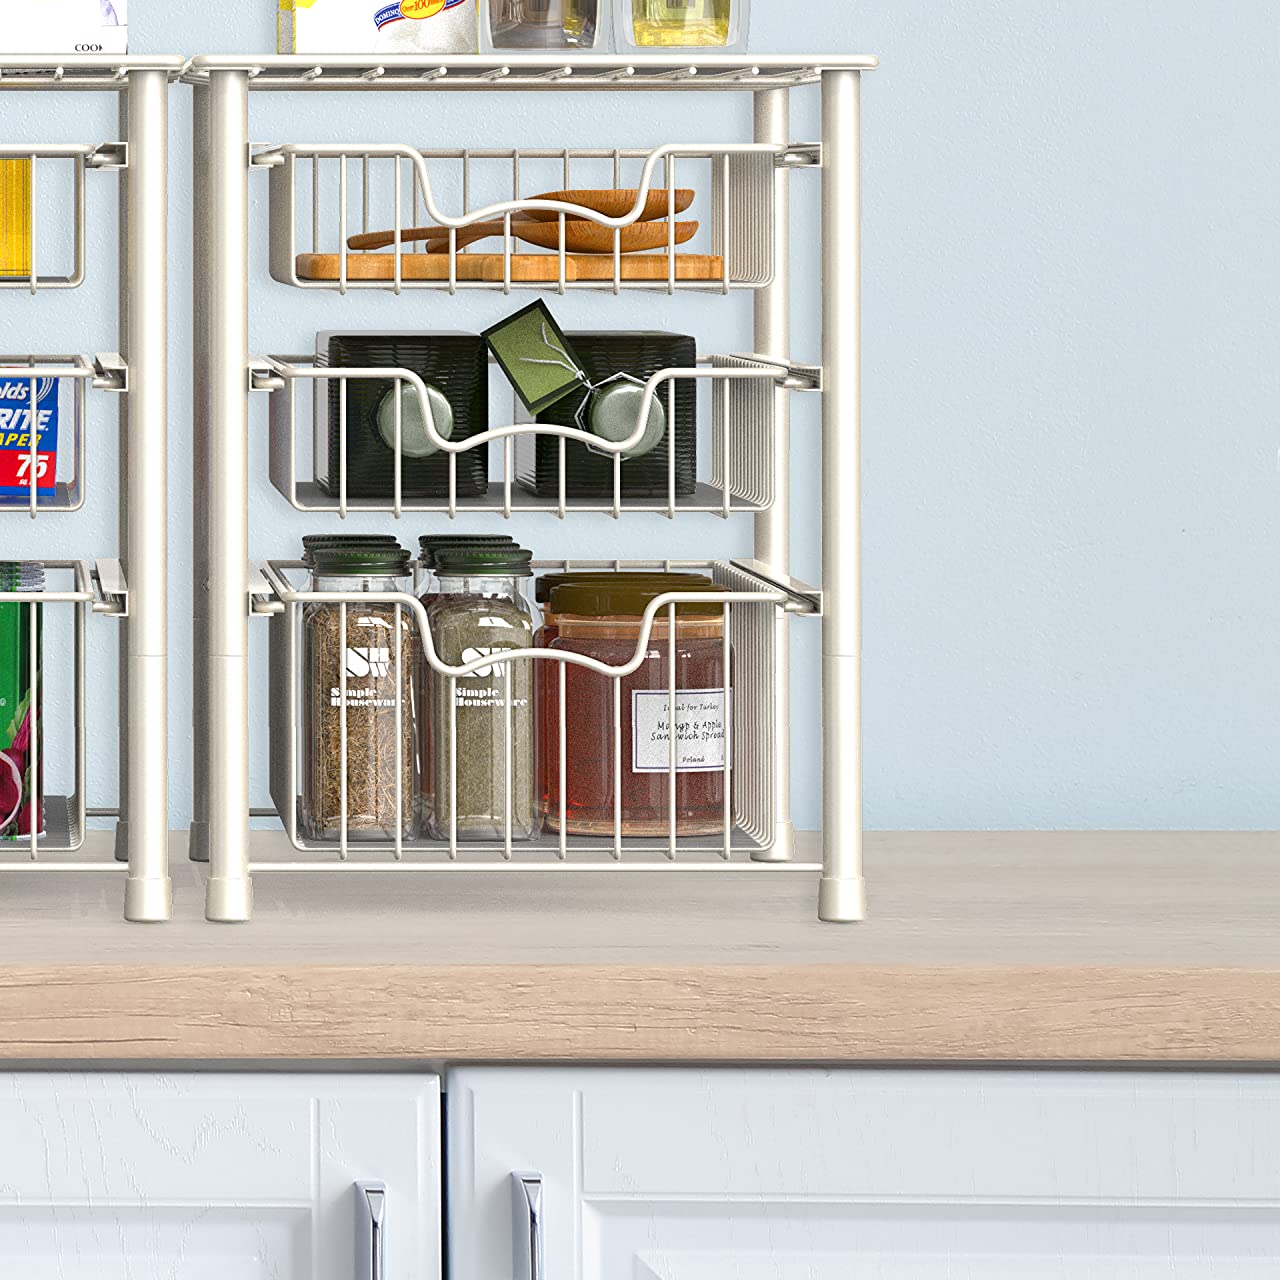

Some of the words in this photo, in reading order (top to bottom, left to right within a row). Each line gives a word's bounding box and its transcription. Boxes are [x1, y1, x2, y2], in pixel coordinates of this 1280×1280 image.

[374, 8, 400, 24] DOMINO
[16, 454, 49, 478] 75
[330, 688, 377, 698] Smple
[456, 688, 499, 698] Simple
[456, 697, 528, 706] Housewre
[650, 730, 699, 741] Sanwich
